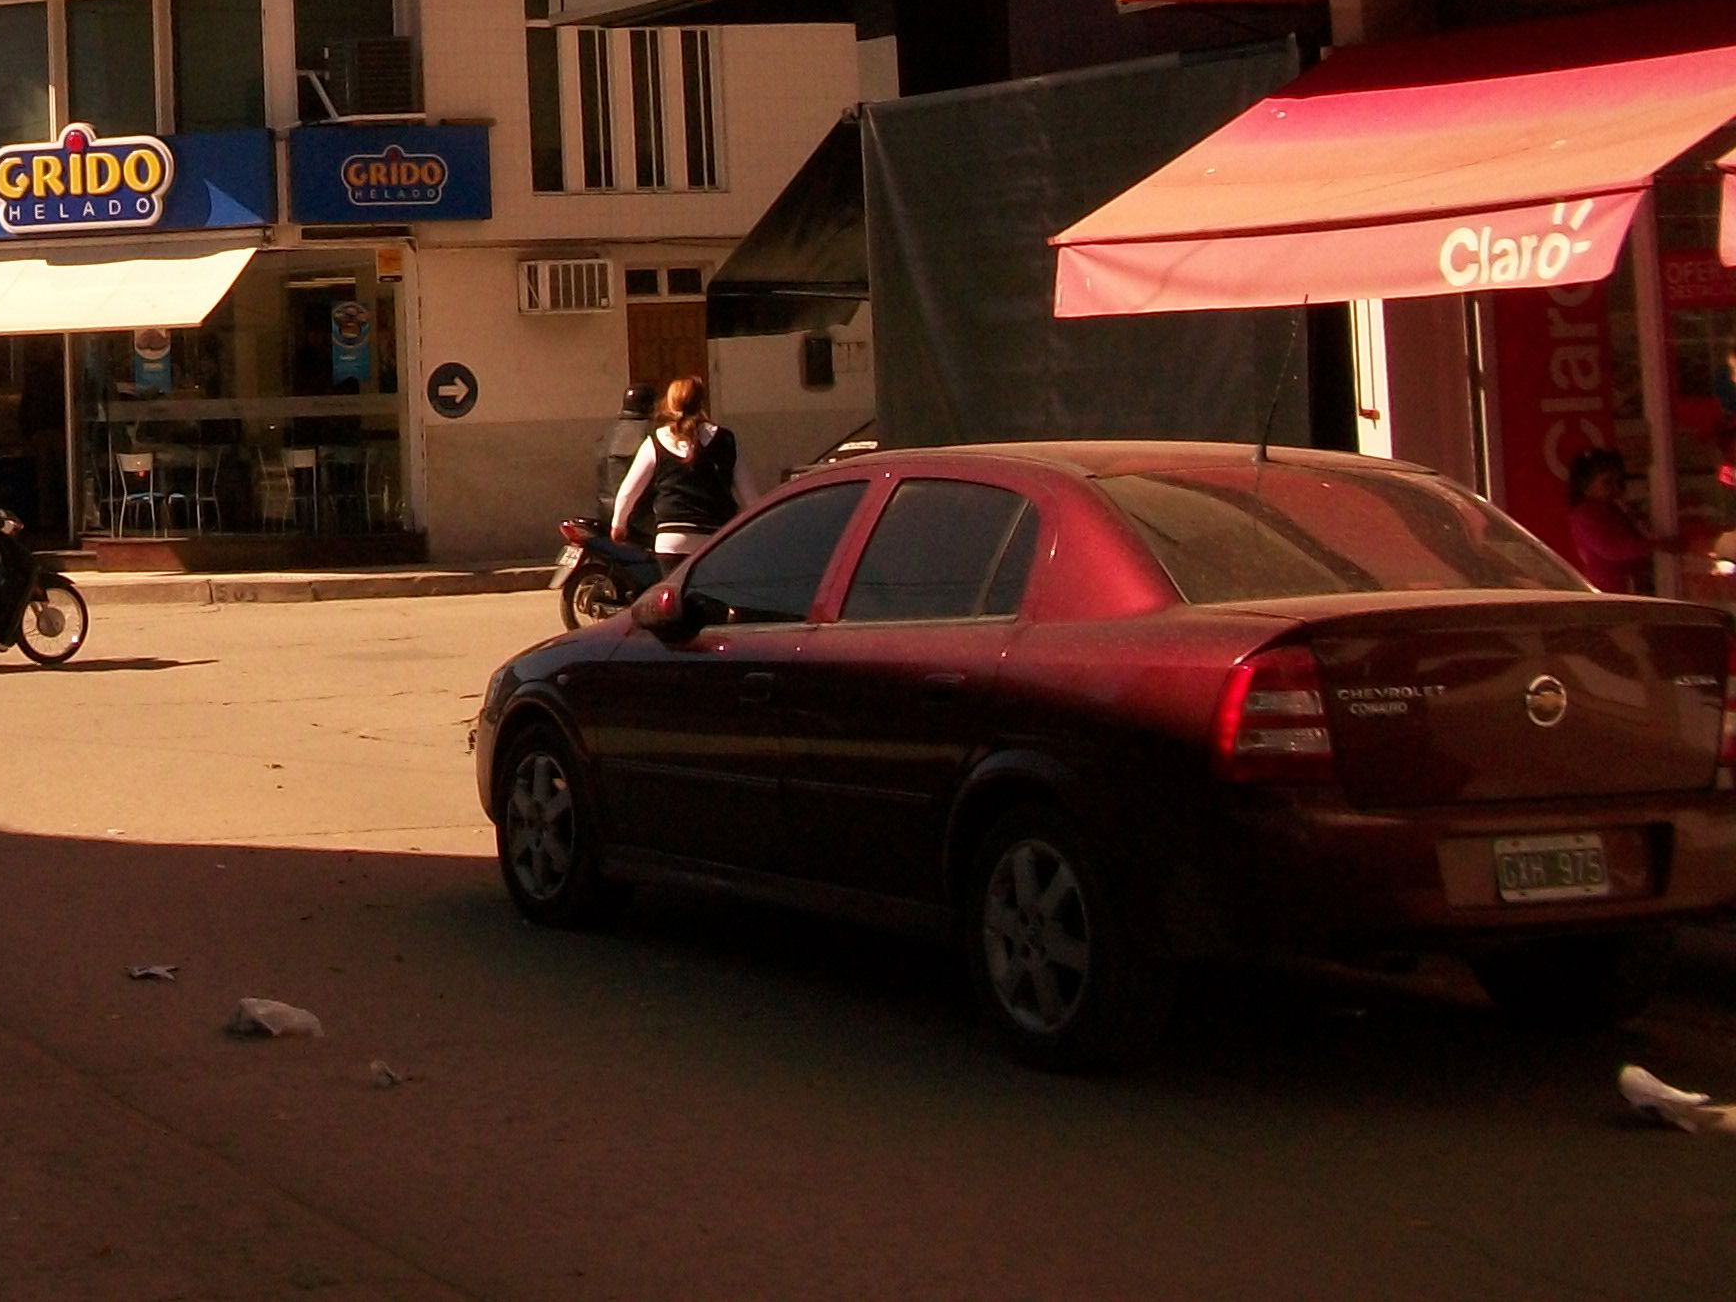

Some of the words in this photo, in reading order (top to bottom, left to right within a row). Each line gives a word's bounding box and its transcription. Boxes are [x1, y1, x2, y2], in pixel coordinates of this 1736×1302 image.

[346, 160, 443, 186] GRIDO
[355, 188, 436, 200] HELADO
[9, 197, 151, 221] HELADO
[1440, 224, 1572, 287] Claro
[1337, 684, 1447, 700] CHEVROLET
